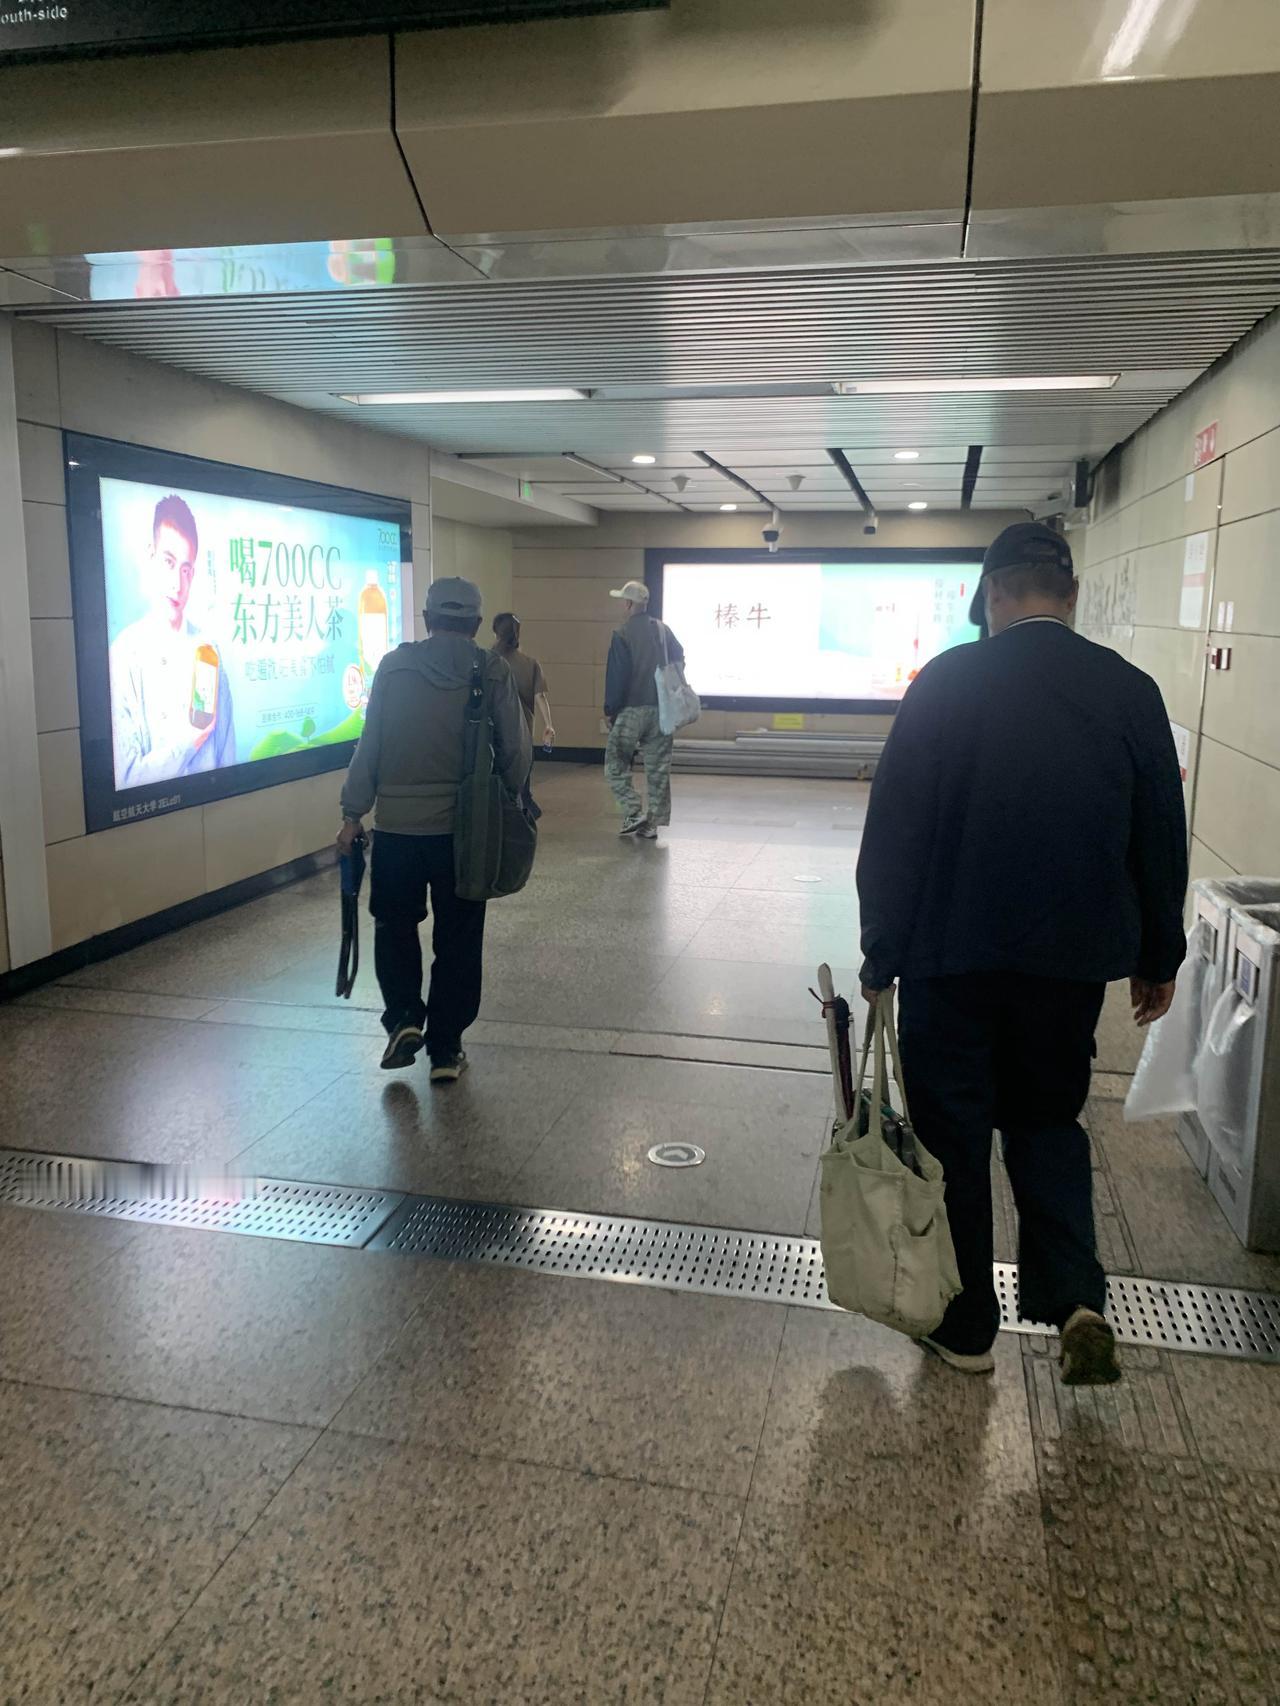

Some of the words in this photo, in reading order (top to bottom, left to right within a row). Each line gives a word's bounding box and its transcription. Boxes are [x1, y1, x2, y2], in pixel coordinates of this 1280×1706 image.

[1, 5, 68, 24] outh-side
[229, 537, 342, 590] 喝700CC
[230, 593, 344, 645] 东方美人茶
